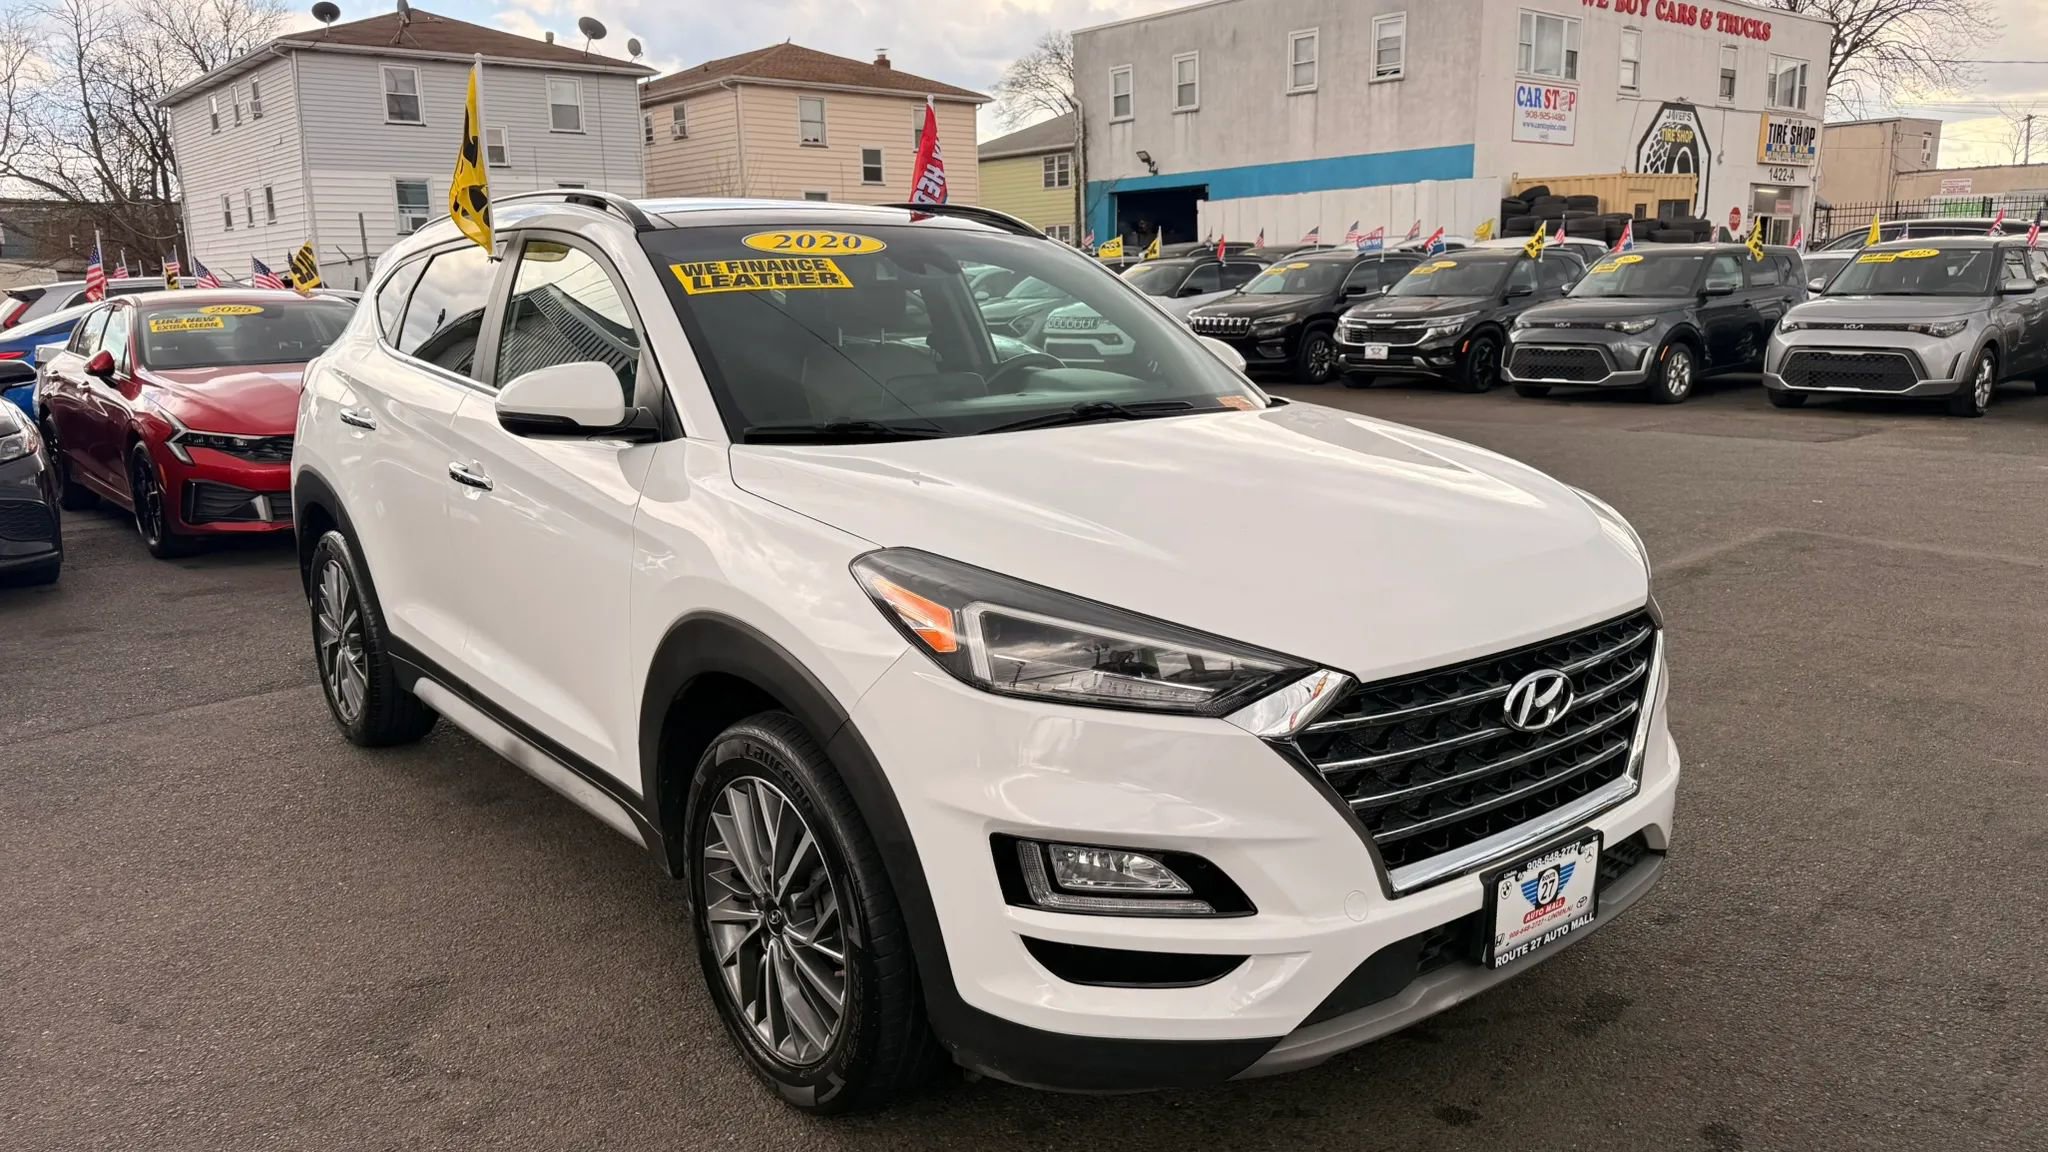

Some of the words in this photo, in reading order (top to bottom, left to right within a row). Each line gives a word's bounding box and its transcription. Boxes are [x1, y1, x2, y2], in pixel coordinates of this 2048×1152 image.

[1655, 0, 1698, 26] CARS
[1700, 8, 1713, 30] &
[1716, 11, 1771, 41] TRUCKS
[1517, 85, 1542, 109] CAR
[1661, 127, 1676, 143] TIRE
[1676, 128, 1694, 145] SHOP
[1769, 123, 1788, 145] TIRE
[1790, 125, 1816, 147] SHOP
[1769, 168, 1795, 182] 1422-A
[773, 234, 863, 250] 2020
[680, 262, 721, 277] WE
[727, 259, 829, 274] FINANCE
[692, 272, 843, 290] LEATHER
[1541, 872, 1556, 882] ROUTE
[1540, 878, 1556, 901] 27
[1525, 908, 1545, 922] AUTO
[1546, 900, 1563, 913] MALL
[1495, 943, 1528, 968] ROUTE
[1530, 936, 1542, 951] 27
[1543, 924, 1569, 945] AUTO
[1571, 912, 1594, 931] MALL
